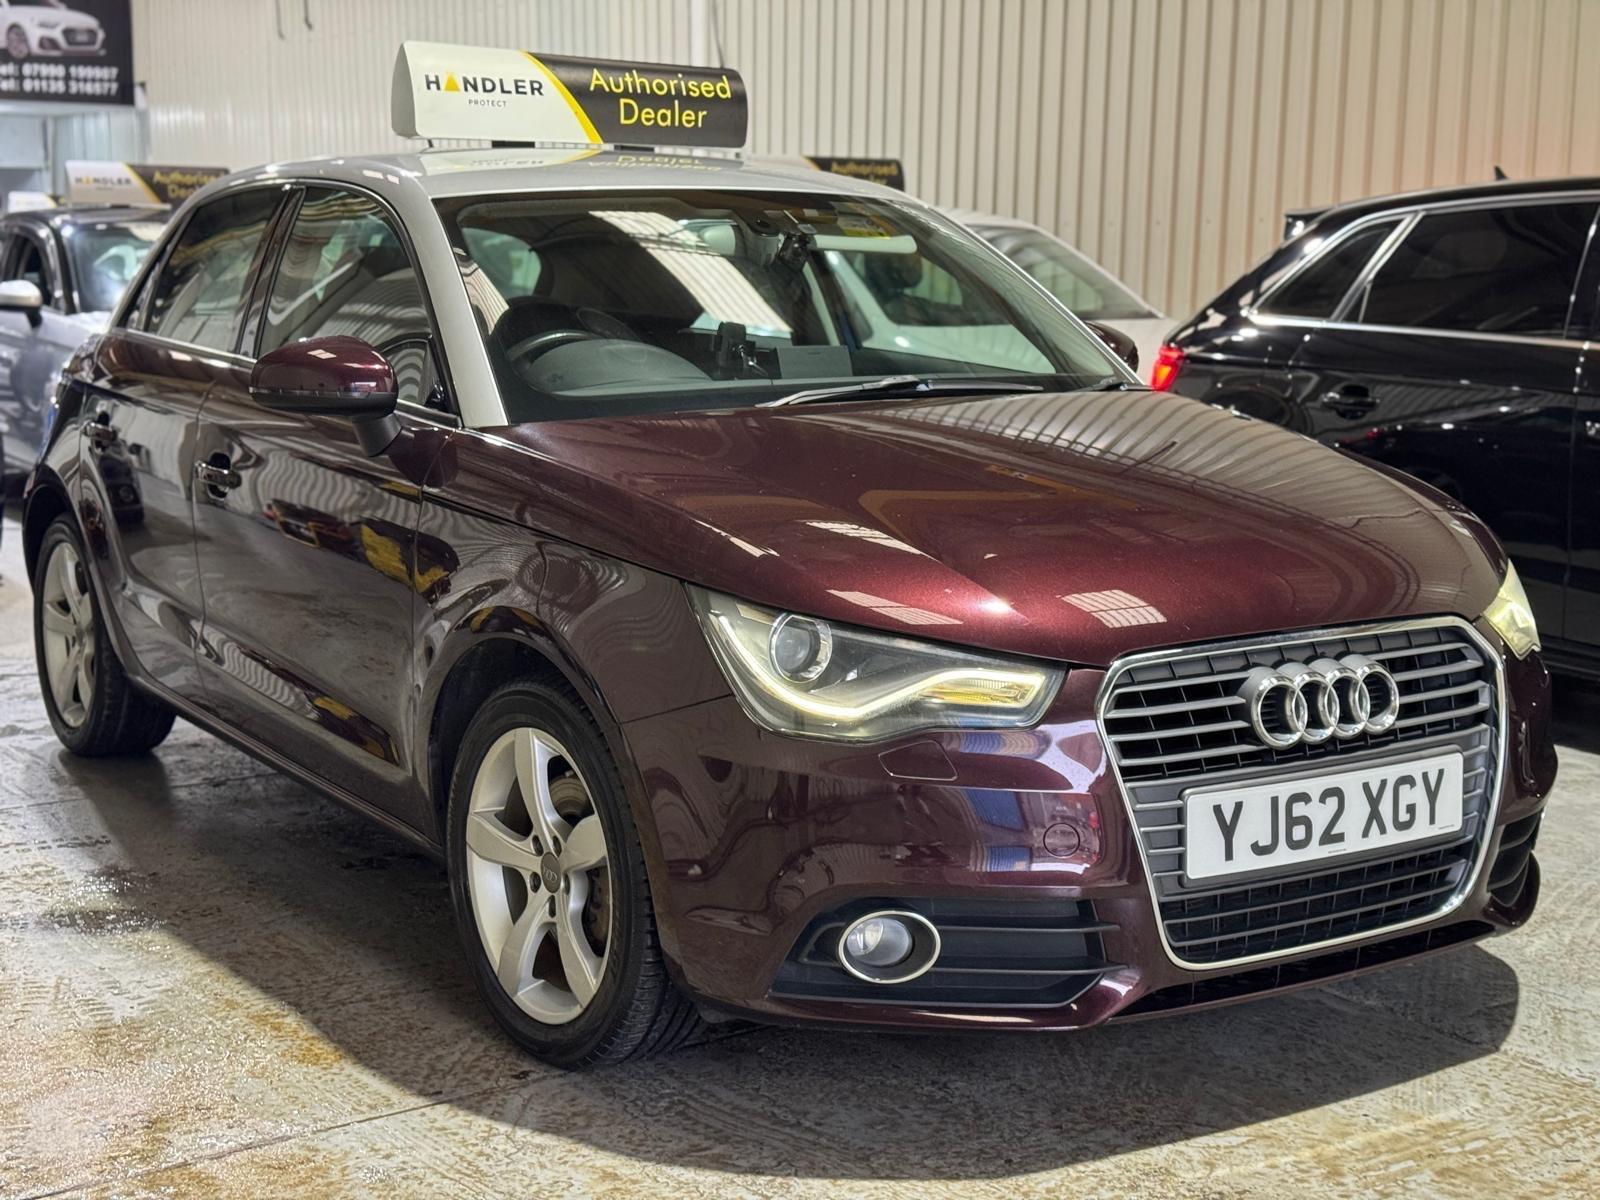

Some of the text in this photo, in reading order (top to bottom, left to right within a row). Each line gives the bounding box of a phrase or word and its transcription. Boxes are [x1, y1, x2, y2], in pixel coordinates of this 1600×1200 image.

[589, 68, 732, 100] Authorised
[468, 98, 507, 108] PROTECT
[618, 98, 708, 128] Dealer
[1212, 768, 1446, 862] YJ62 XGY
